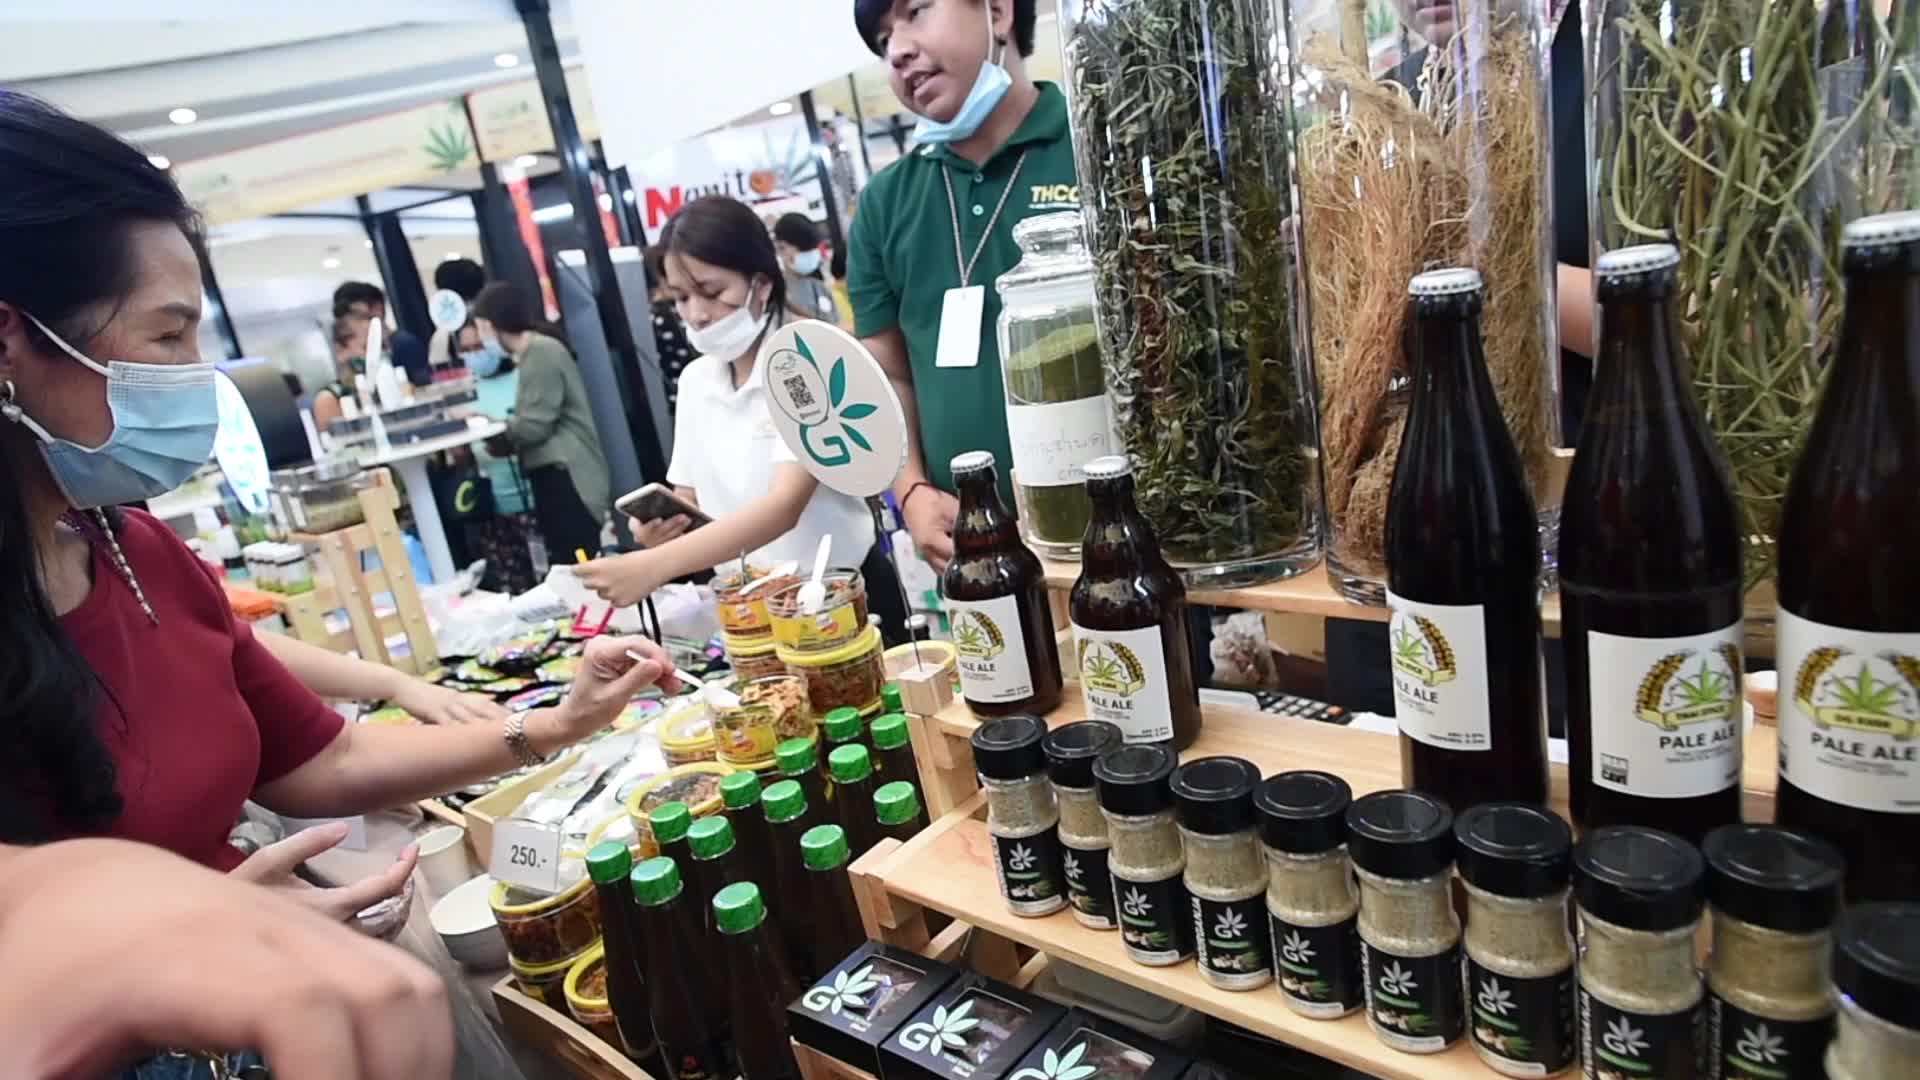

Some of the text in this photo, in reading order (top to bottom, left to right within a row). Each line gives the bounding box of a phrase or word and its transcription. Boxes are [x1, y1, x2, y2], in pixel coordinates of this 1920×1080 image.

[1111, 700, 1135, 710] ALE
[1413, 687, 1440, 704] ALE
[1659, 724, 1736, 749] PALE ALE
[1811, 731, 1917, 761] PALE ALE
